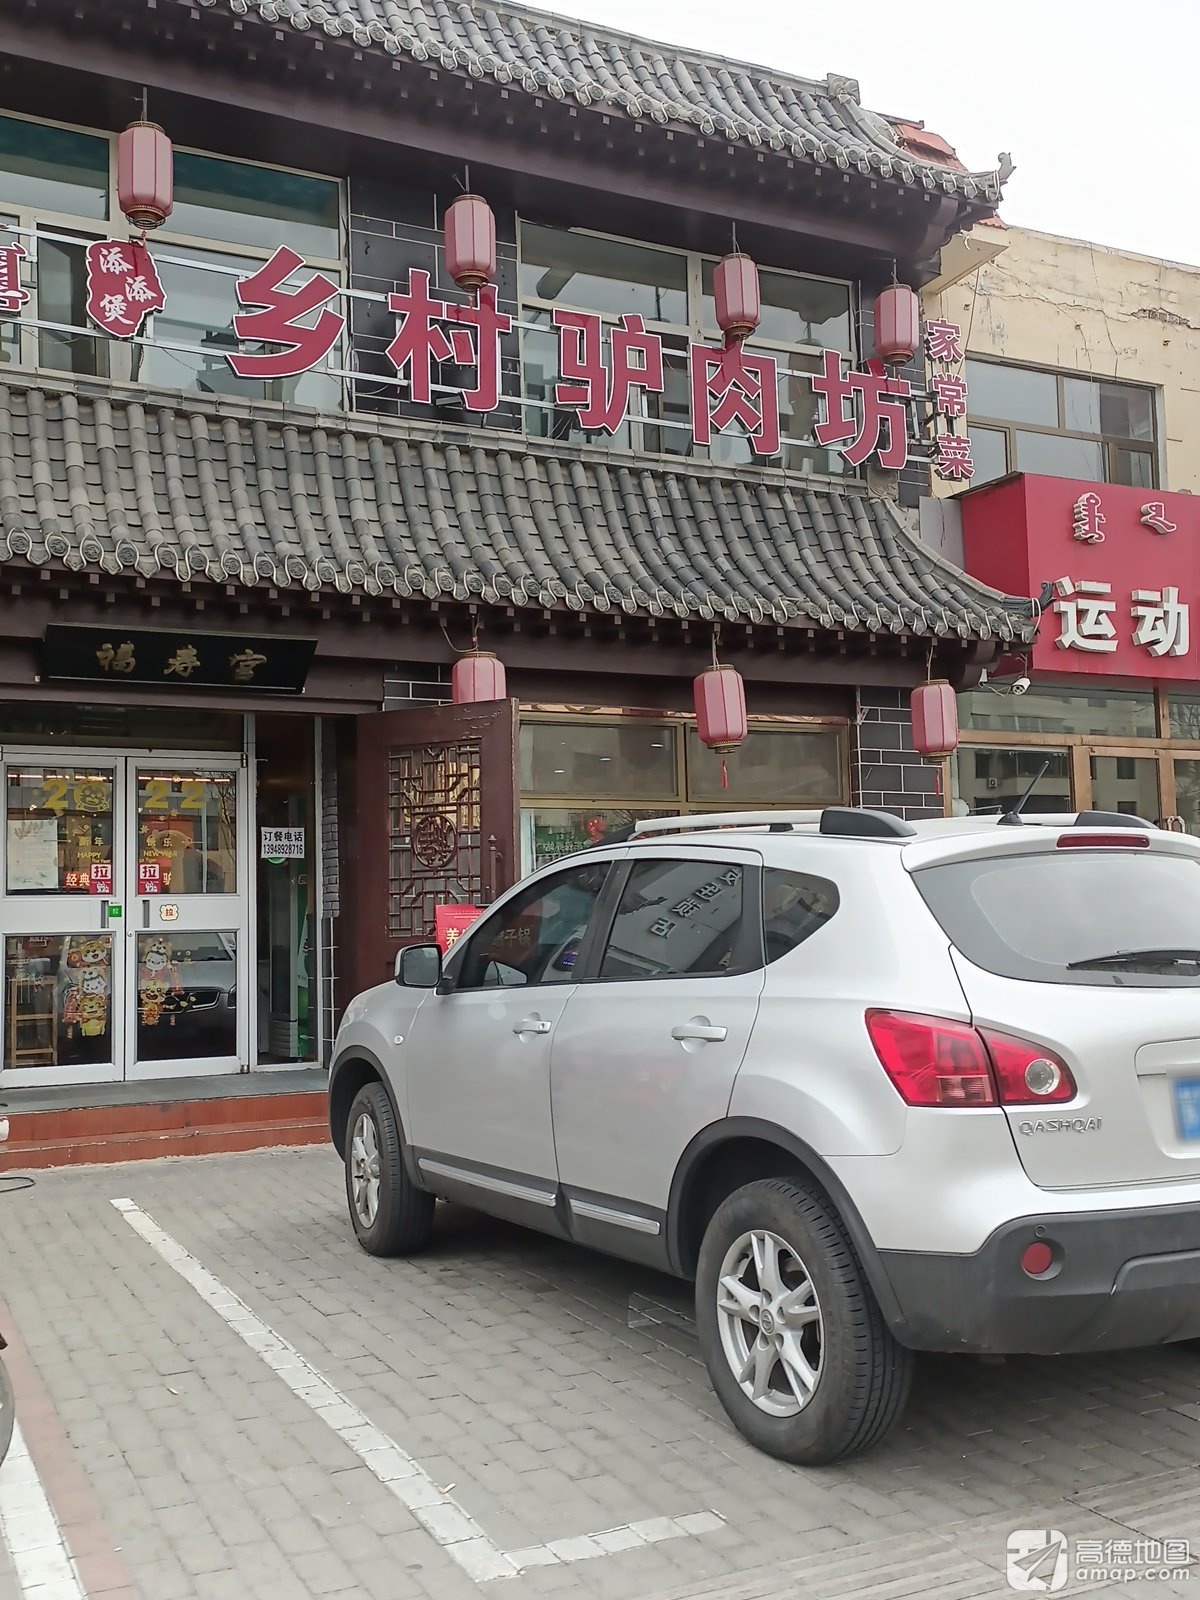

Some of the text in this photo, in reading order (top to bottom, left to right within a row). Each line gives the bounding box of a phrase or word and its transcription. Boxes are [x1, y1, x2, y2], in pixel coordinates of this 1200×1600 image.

[227, 243, 912, 472] 乡村驴肉坊
[926, 317, 975, 480] 家常菜
[1054, 575, 1190, 658] 运动
[263, 830, 303, 842] 订餐电话
[263, 843, 304, 855] 13948928716
[94, 865, 109, 878] 拉
[142, 865, 157, 878] 拉
[1018, 1116, 1103, 1137] QASHQAI
